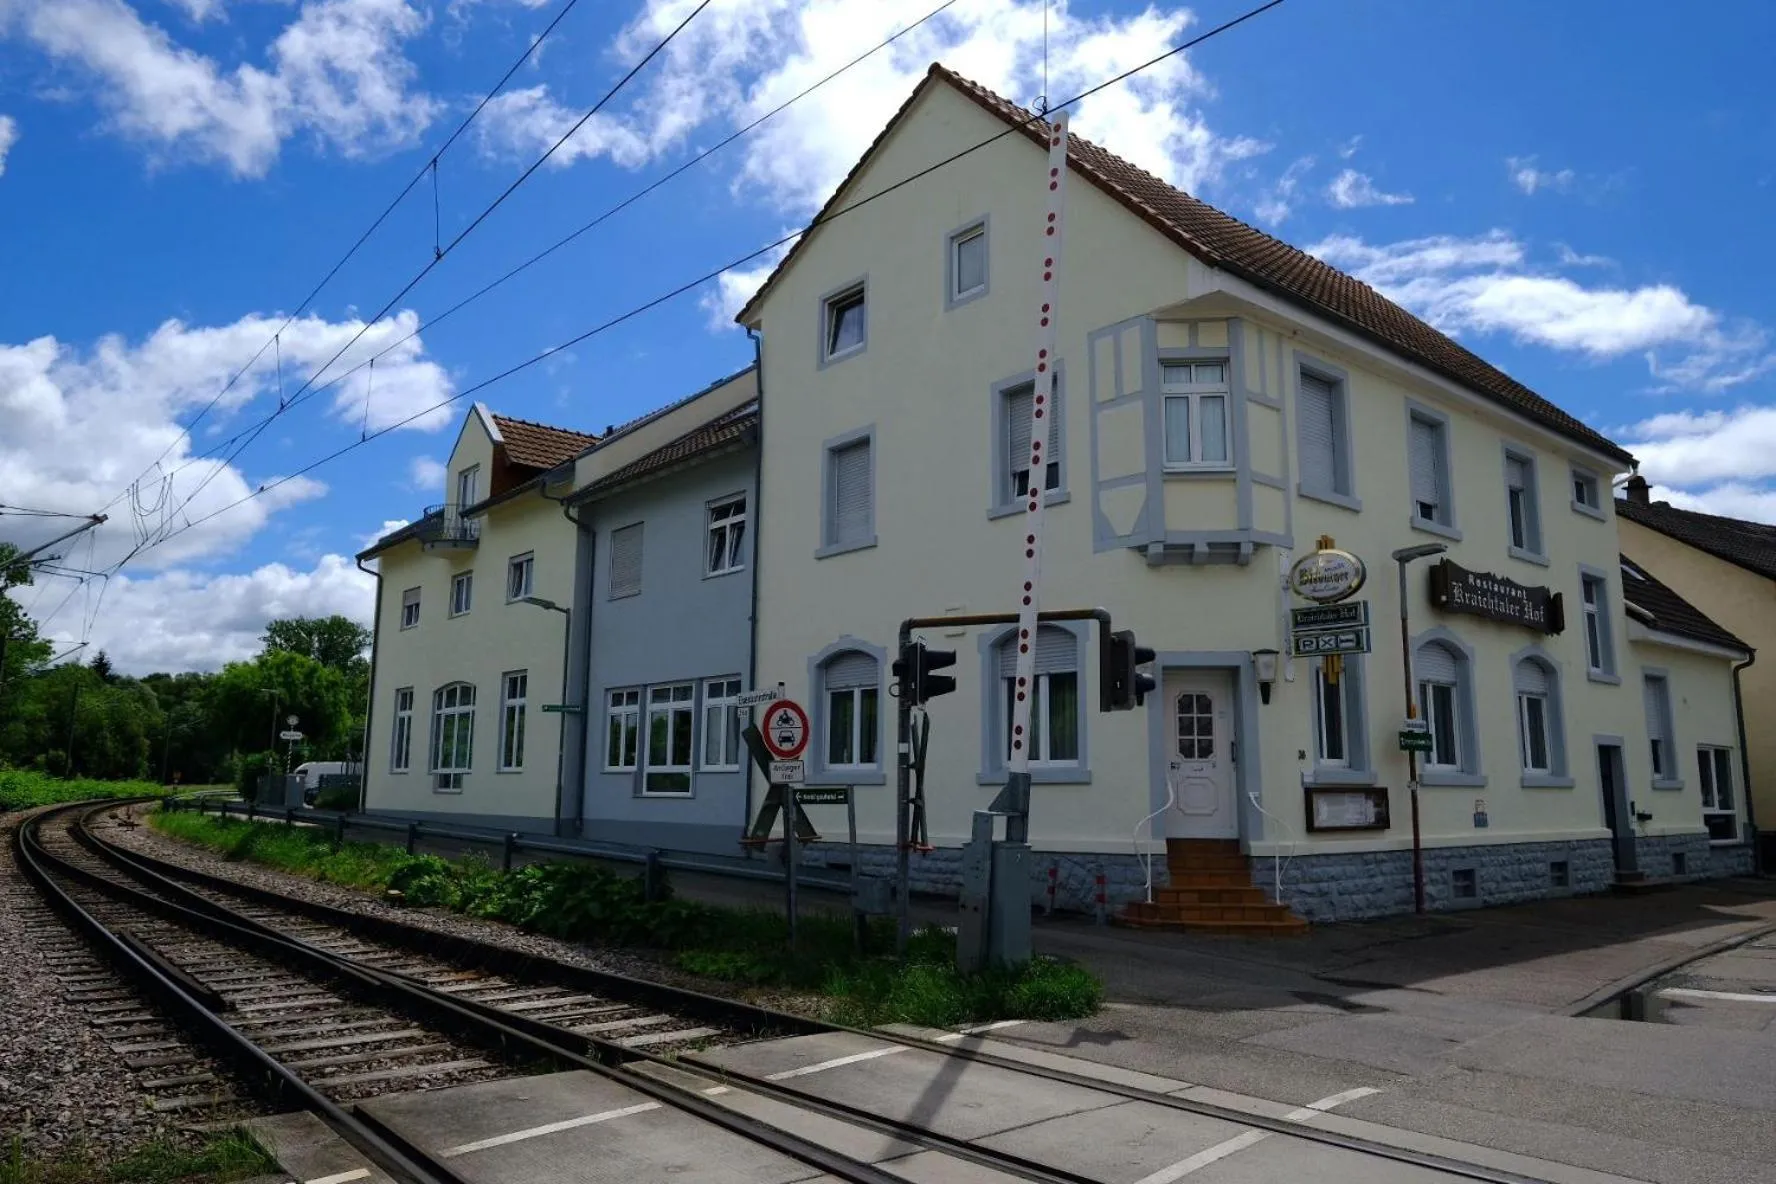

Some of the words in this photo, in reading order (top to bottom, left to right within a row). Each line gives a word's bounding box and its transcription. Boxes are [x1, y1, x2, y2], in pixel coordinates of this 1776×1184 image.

[1451, 581, 1520, 616] Kraichtaler
[1523, 600, 1545, 623] Hof
[1468, 573, 1527, 600] Restaurant
